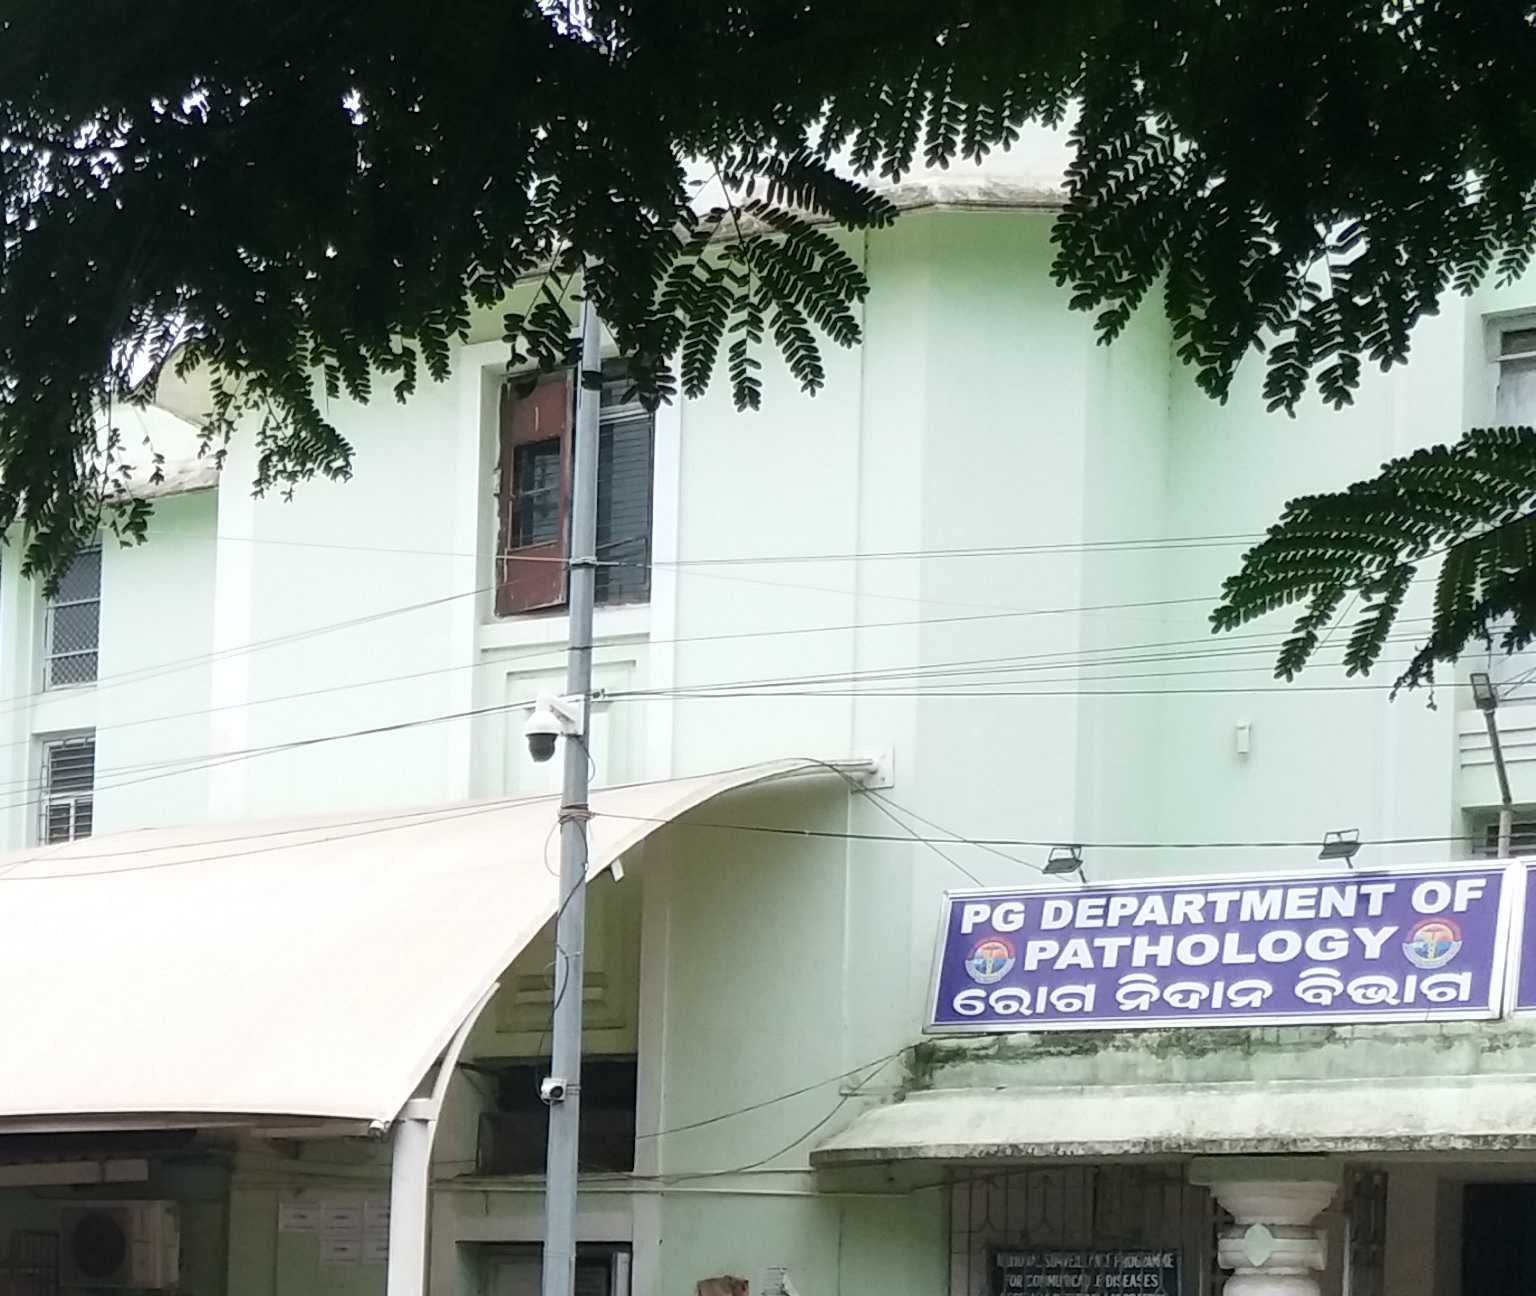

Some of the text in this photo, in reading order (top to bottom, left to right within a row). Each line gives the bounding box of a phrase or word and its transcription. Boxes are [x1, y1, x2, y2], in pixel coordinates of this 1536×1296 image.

[960, 878, 1487, 934] PG DEPARTMENT OF
[1024, 926, 1399, 971] PATHOLOGY
[952, 967, 1472, 1016] ରୋଗ ନିଦାନ ବିଭାଗ
[1026, 1274, 1102, 1288] COMMUNICAE
[1105, 1274, 1159, 1288] DISEASES
